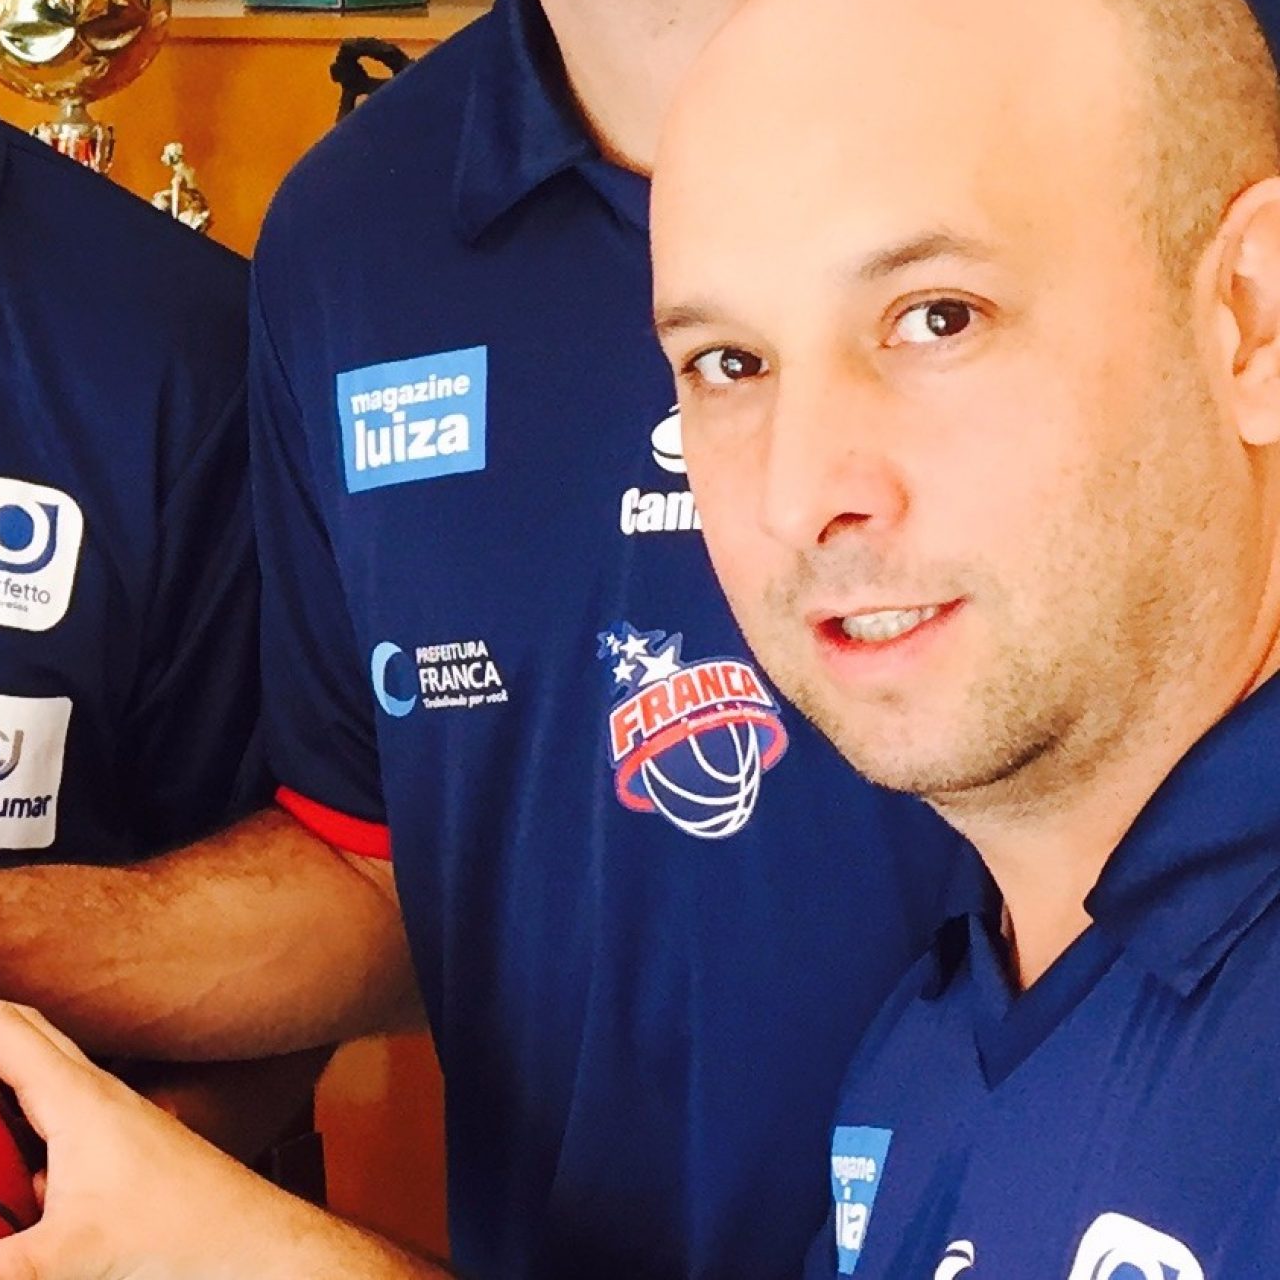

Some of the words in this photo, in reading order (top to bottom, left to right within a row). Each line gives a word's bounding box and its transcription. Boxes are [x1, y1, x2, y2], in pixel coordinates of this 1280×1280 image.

[350, 373, 471, 416] magazine
[354, 410, 470, 472] luiza
[621, 487, 702, 536] Cam
[416, 639, 489, 664] PREFEITURA
[419, 660, 503, 694] FRANCA
[609, 661, 772, 762] FRANCA
